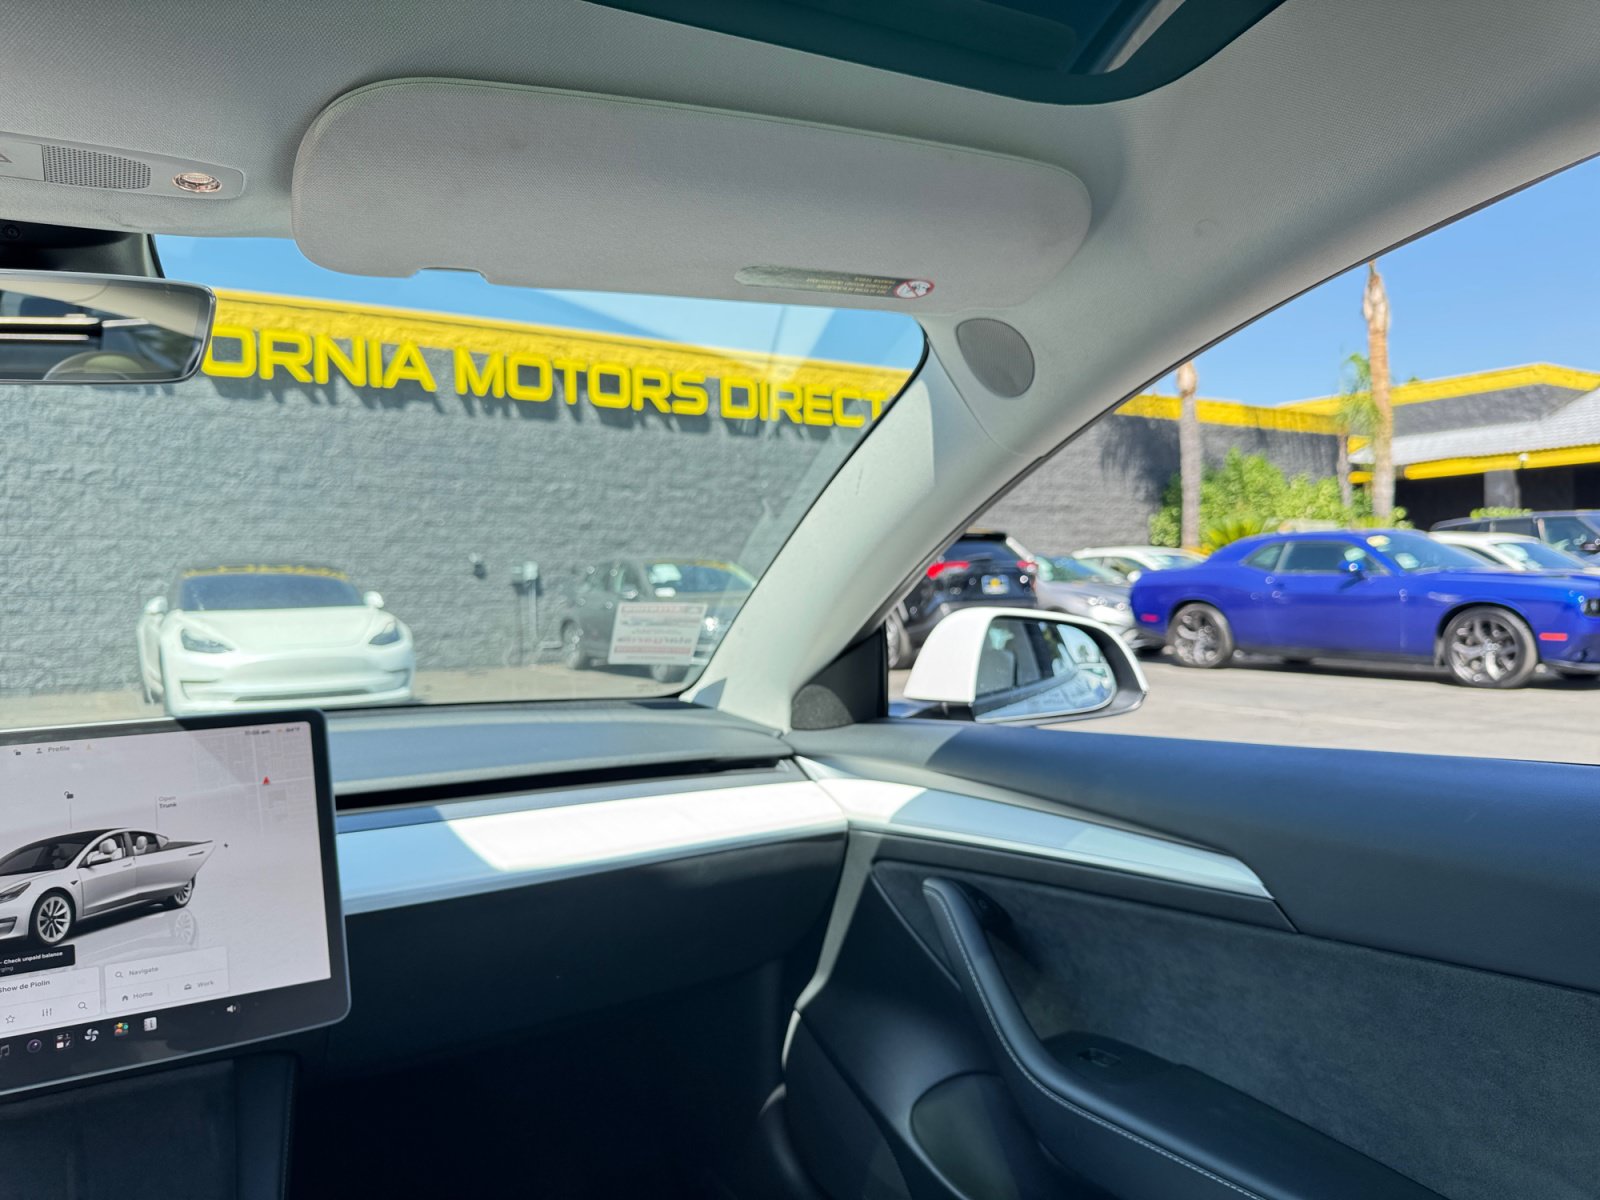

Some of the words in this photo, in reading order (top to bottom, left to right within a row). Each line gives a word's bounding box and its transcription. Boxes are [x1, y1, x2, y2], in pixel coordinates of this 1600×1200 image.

[453, 348, 709, 415] MOTORS
[720, 377, 888, 428] DIRECT
[48, 745, 70, 753] Profile
[22, 954, 41, 962] unpaid
[129, 966, 159, 976] Navigate
[198, 980, 214, 988] Work
[133, 991, 153, 999] Home
